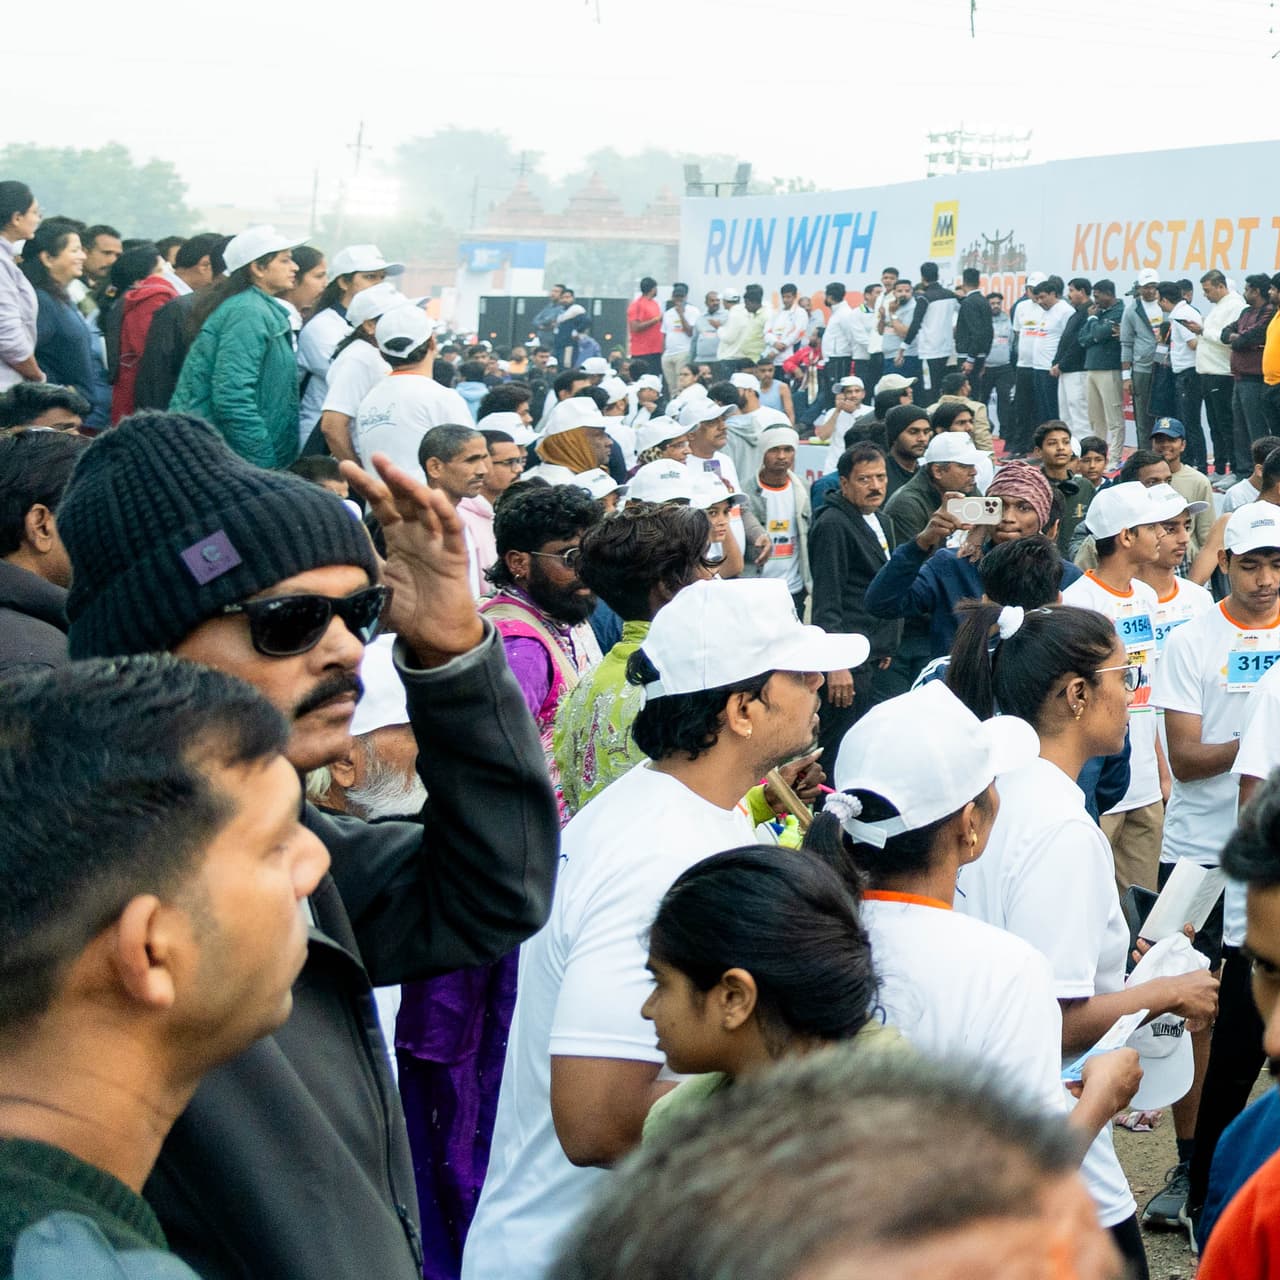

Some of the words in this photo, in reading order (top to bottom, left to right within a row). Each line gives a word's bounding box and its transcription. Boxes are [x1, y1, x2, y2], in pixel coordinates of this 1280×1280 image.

[704, 217, 777, 275] RUN
[783, 210, 878, 276] WITH
[1072, 218, 1260, 271] KICKSTART
